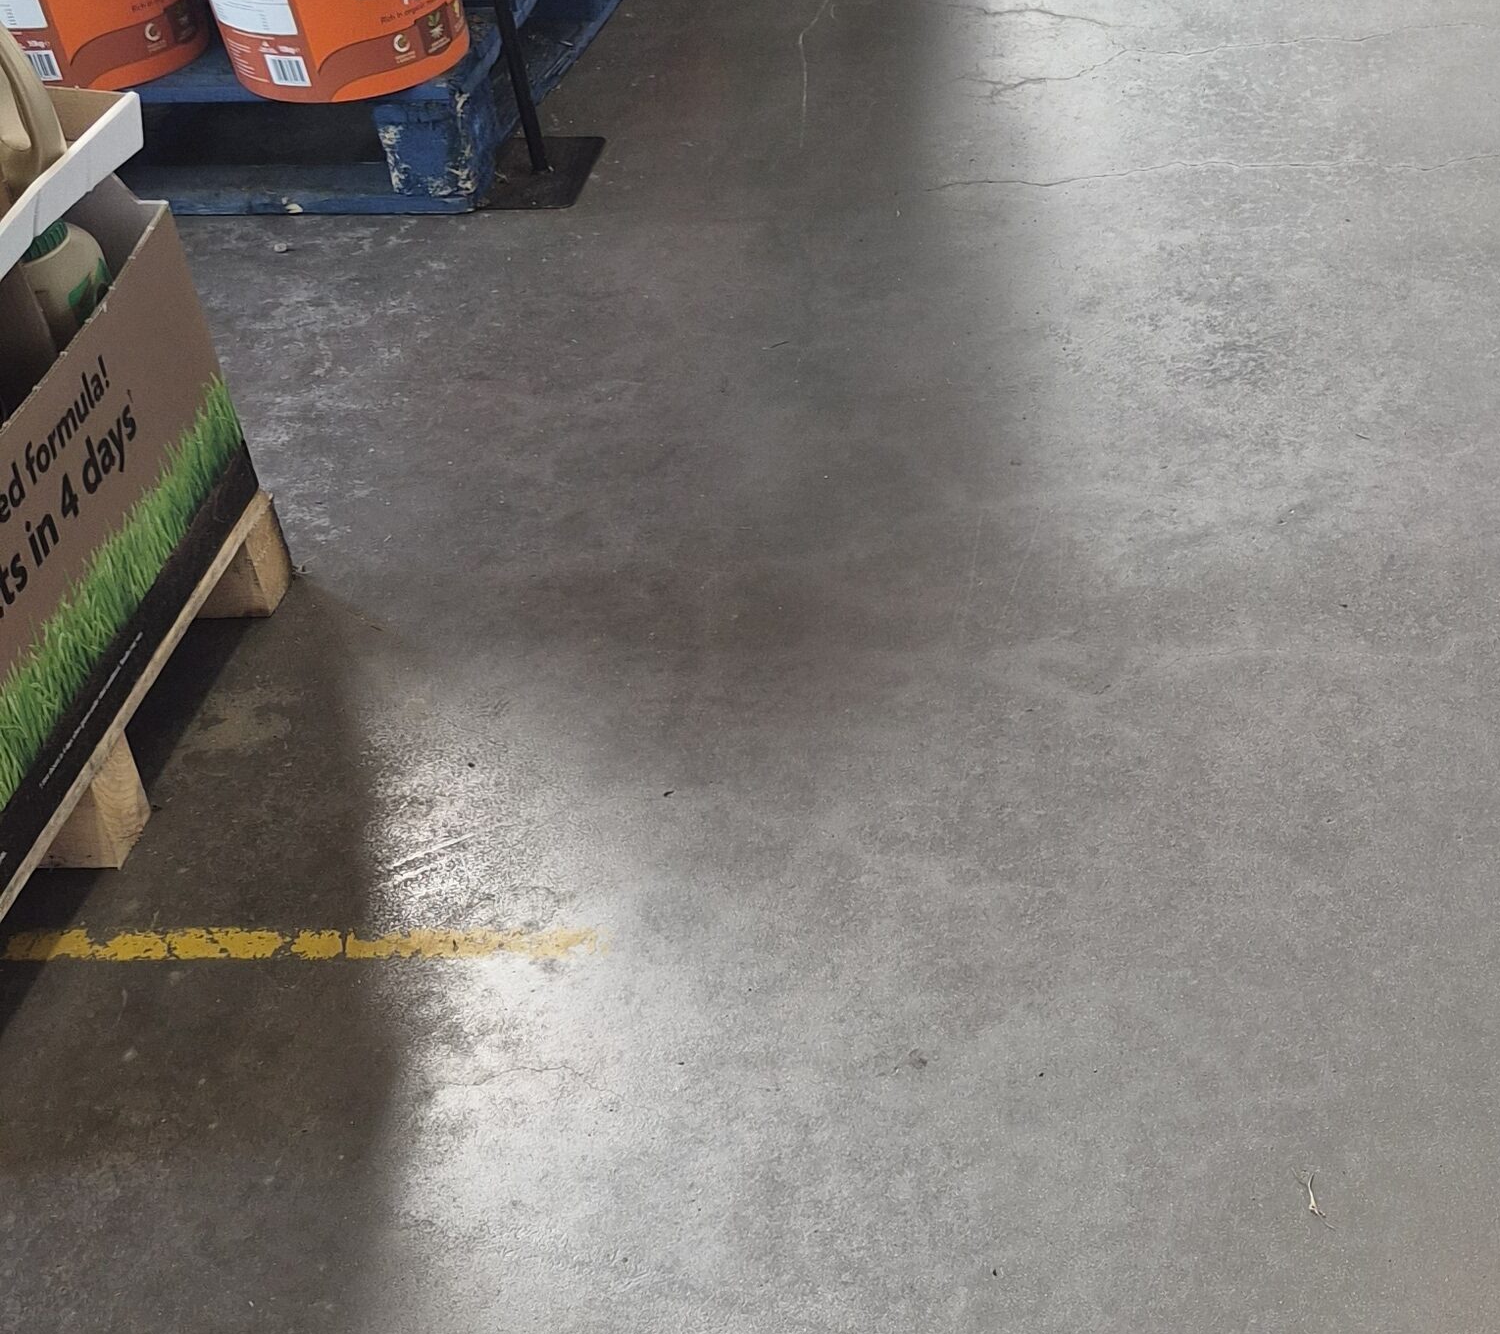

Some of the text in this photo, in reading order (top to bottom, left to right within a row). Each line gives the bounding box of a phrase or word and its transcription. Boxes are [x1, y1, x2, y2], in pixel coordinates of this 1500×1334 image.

[25, 354, 110, 487] formula!
[25, 513, 60, 568] in
[61, 472, 80, 519] 4
